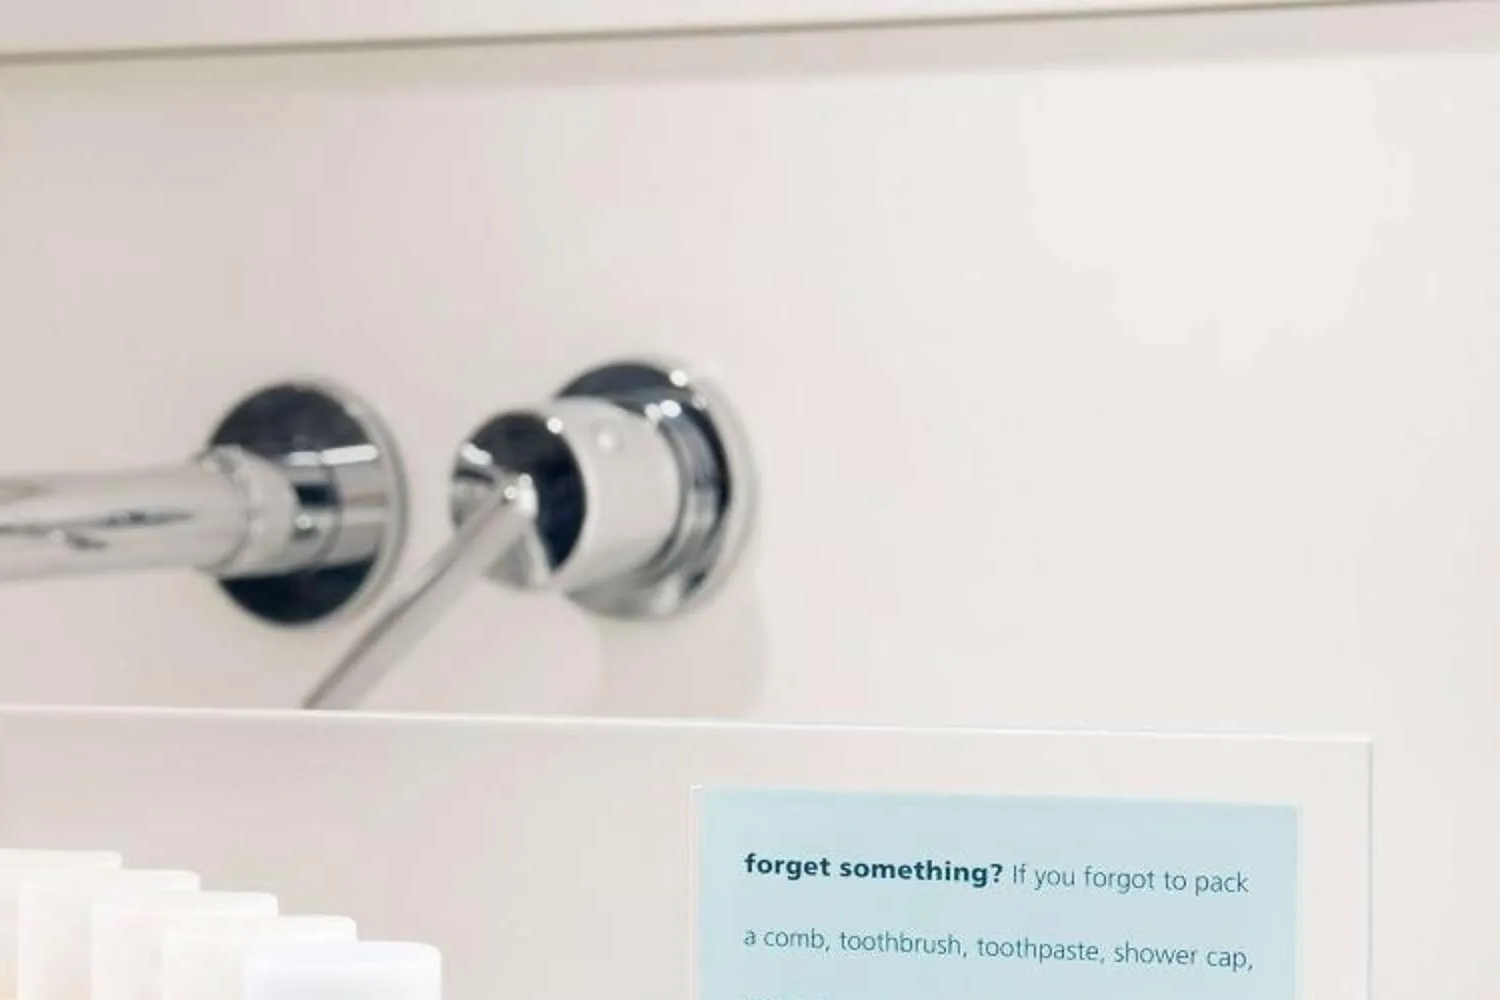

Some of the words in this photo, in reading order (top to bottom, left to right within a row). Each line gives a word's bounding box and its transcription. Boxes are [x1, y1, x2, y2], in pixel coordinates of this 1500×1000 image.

[743, 853, 831, 881] forget
[839, 860, 1003, 888] something?
[1012, 863, 1027, 885] If
[1033, 869, 1076, 891] you
[1084, 866, 1155, 894] forgot
[1163, 871, 1187, 890] to
[1195, 872, 1250, 897] pack
[743, 929, 757, 946] a
[763, 928, 831, 952] comb,
[840, 931, 967, 958] toothbrush,
[976, 937, 1105, 965] toothpaste,
[1113, 940, 1198, 965] shower
[1206, 949, 1253, 972] cap,
